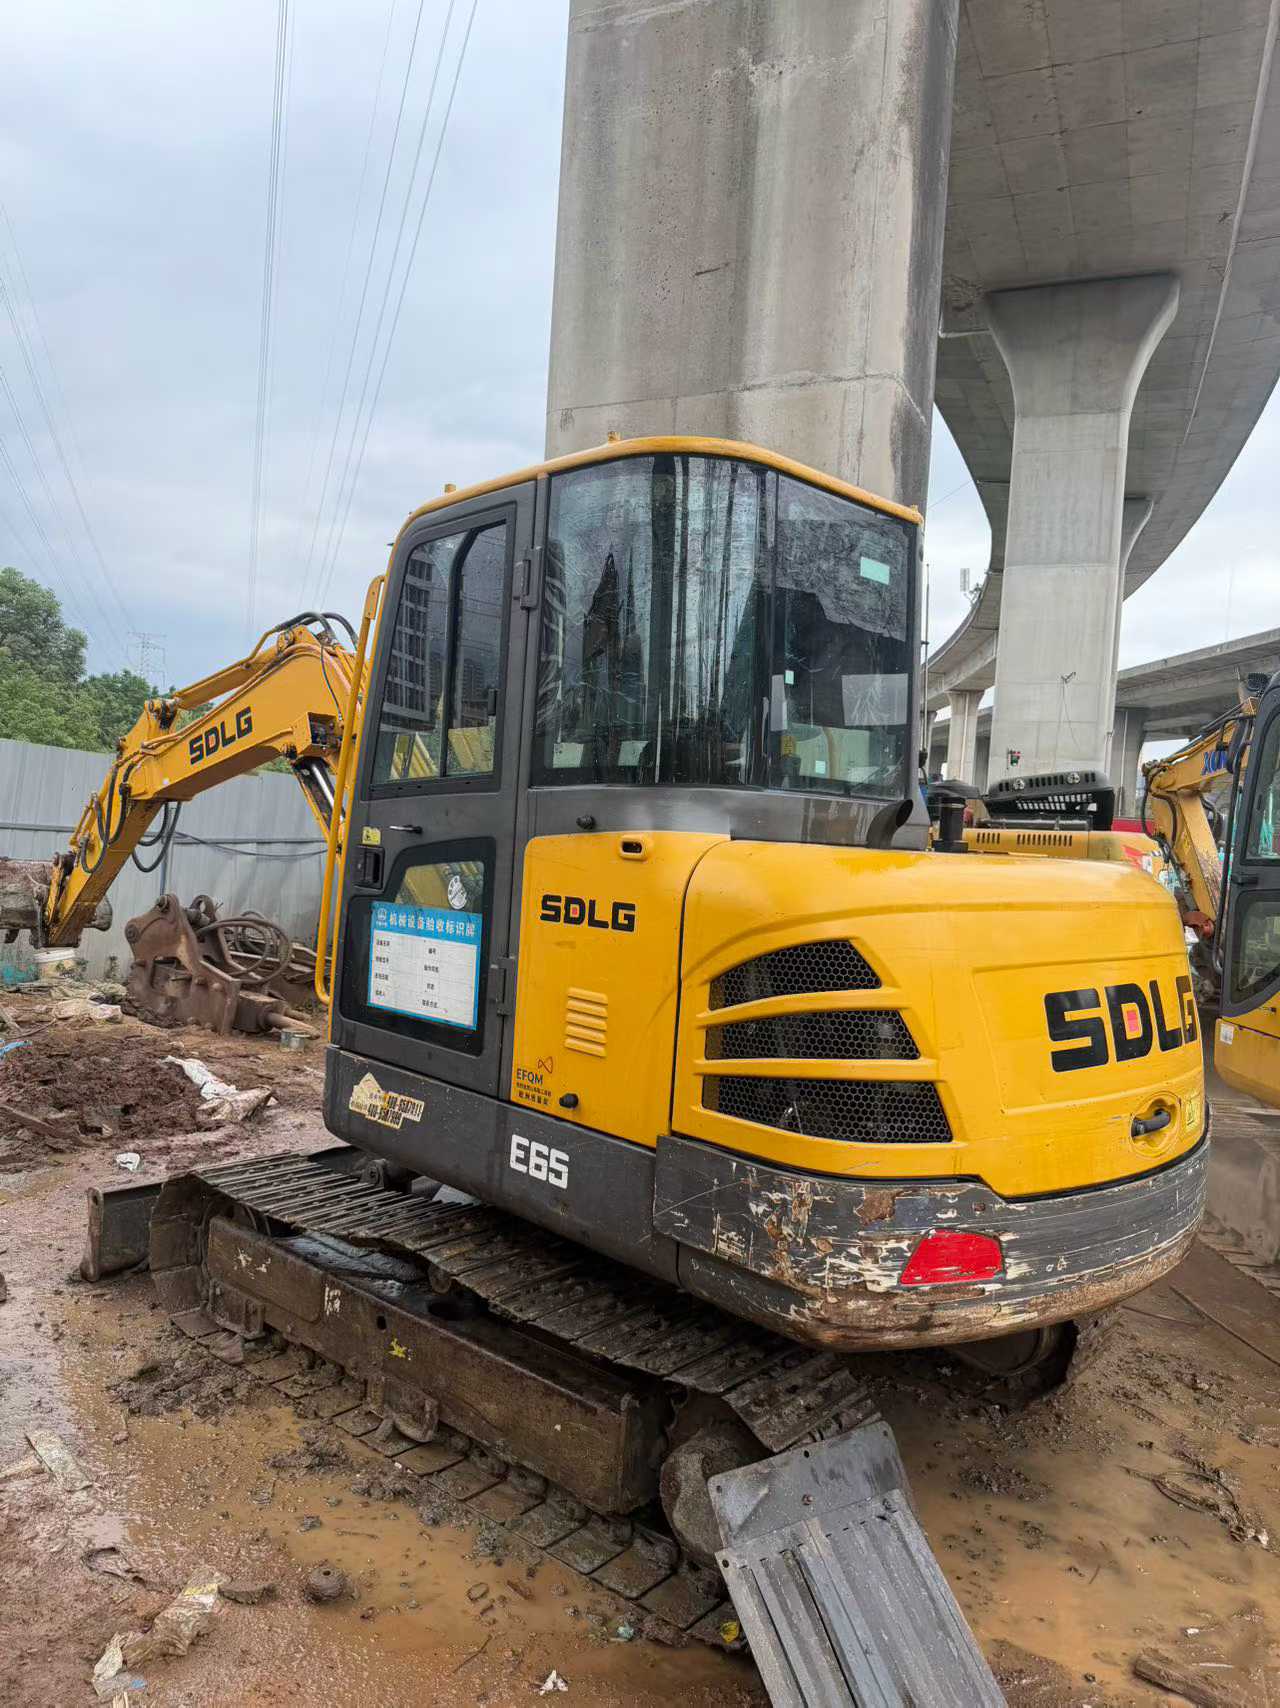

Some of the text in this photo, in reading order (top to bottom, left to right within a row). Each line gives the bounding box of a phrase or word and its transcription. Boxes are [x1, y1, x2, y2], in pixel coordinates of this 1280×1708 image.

[189, 706, 253, 765] SDLG
[540, 894, 636, 932] SDLG
[1044, 975, 1198, 1073] SDLG
[516, 1068, 543, 1086] EFQM
[510, 1134, 569, 1189] E65
